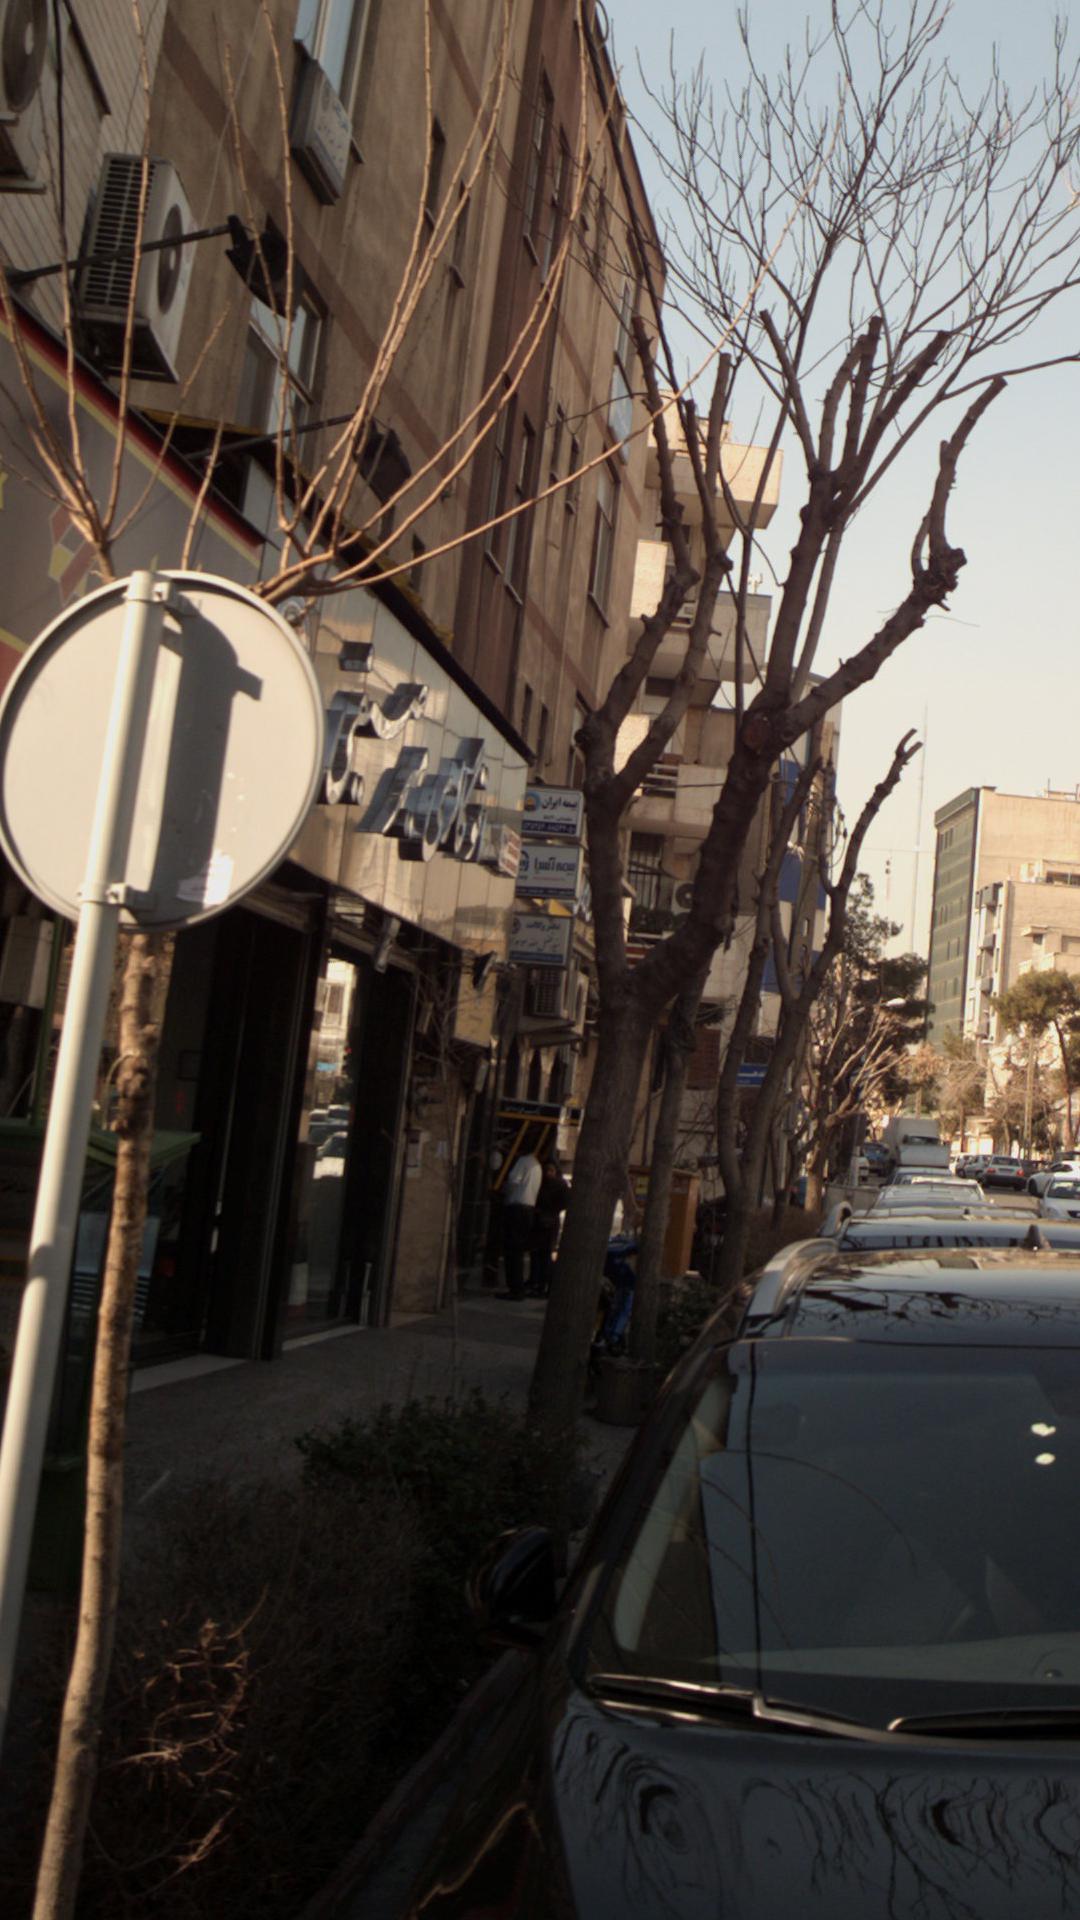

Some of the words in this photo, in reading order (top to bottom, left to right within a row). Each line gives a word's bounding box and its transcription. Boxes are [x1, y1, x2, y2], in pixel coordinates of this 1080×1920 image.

[542, 796, 562, 810] ایران
[563, 800, 578, 810] بیمه
[534, 856, 556, 873] آسیا
